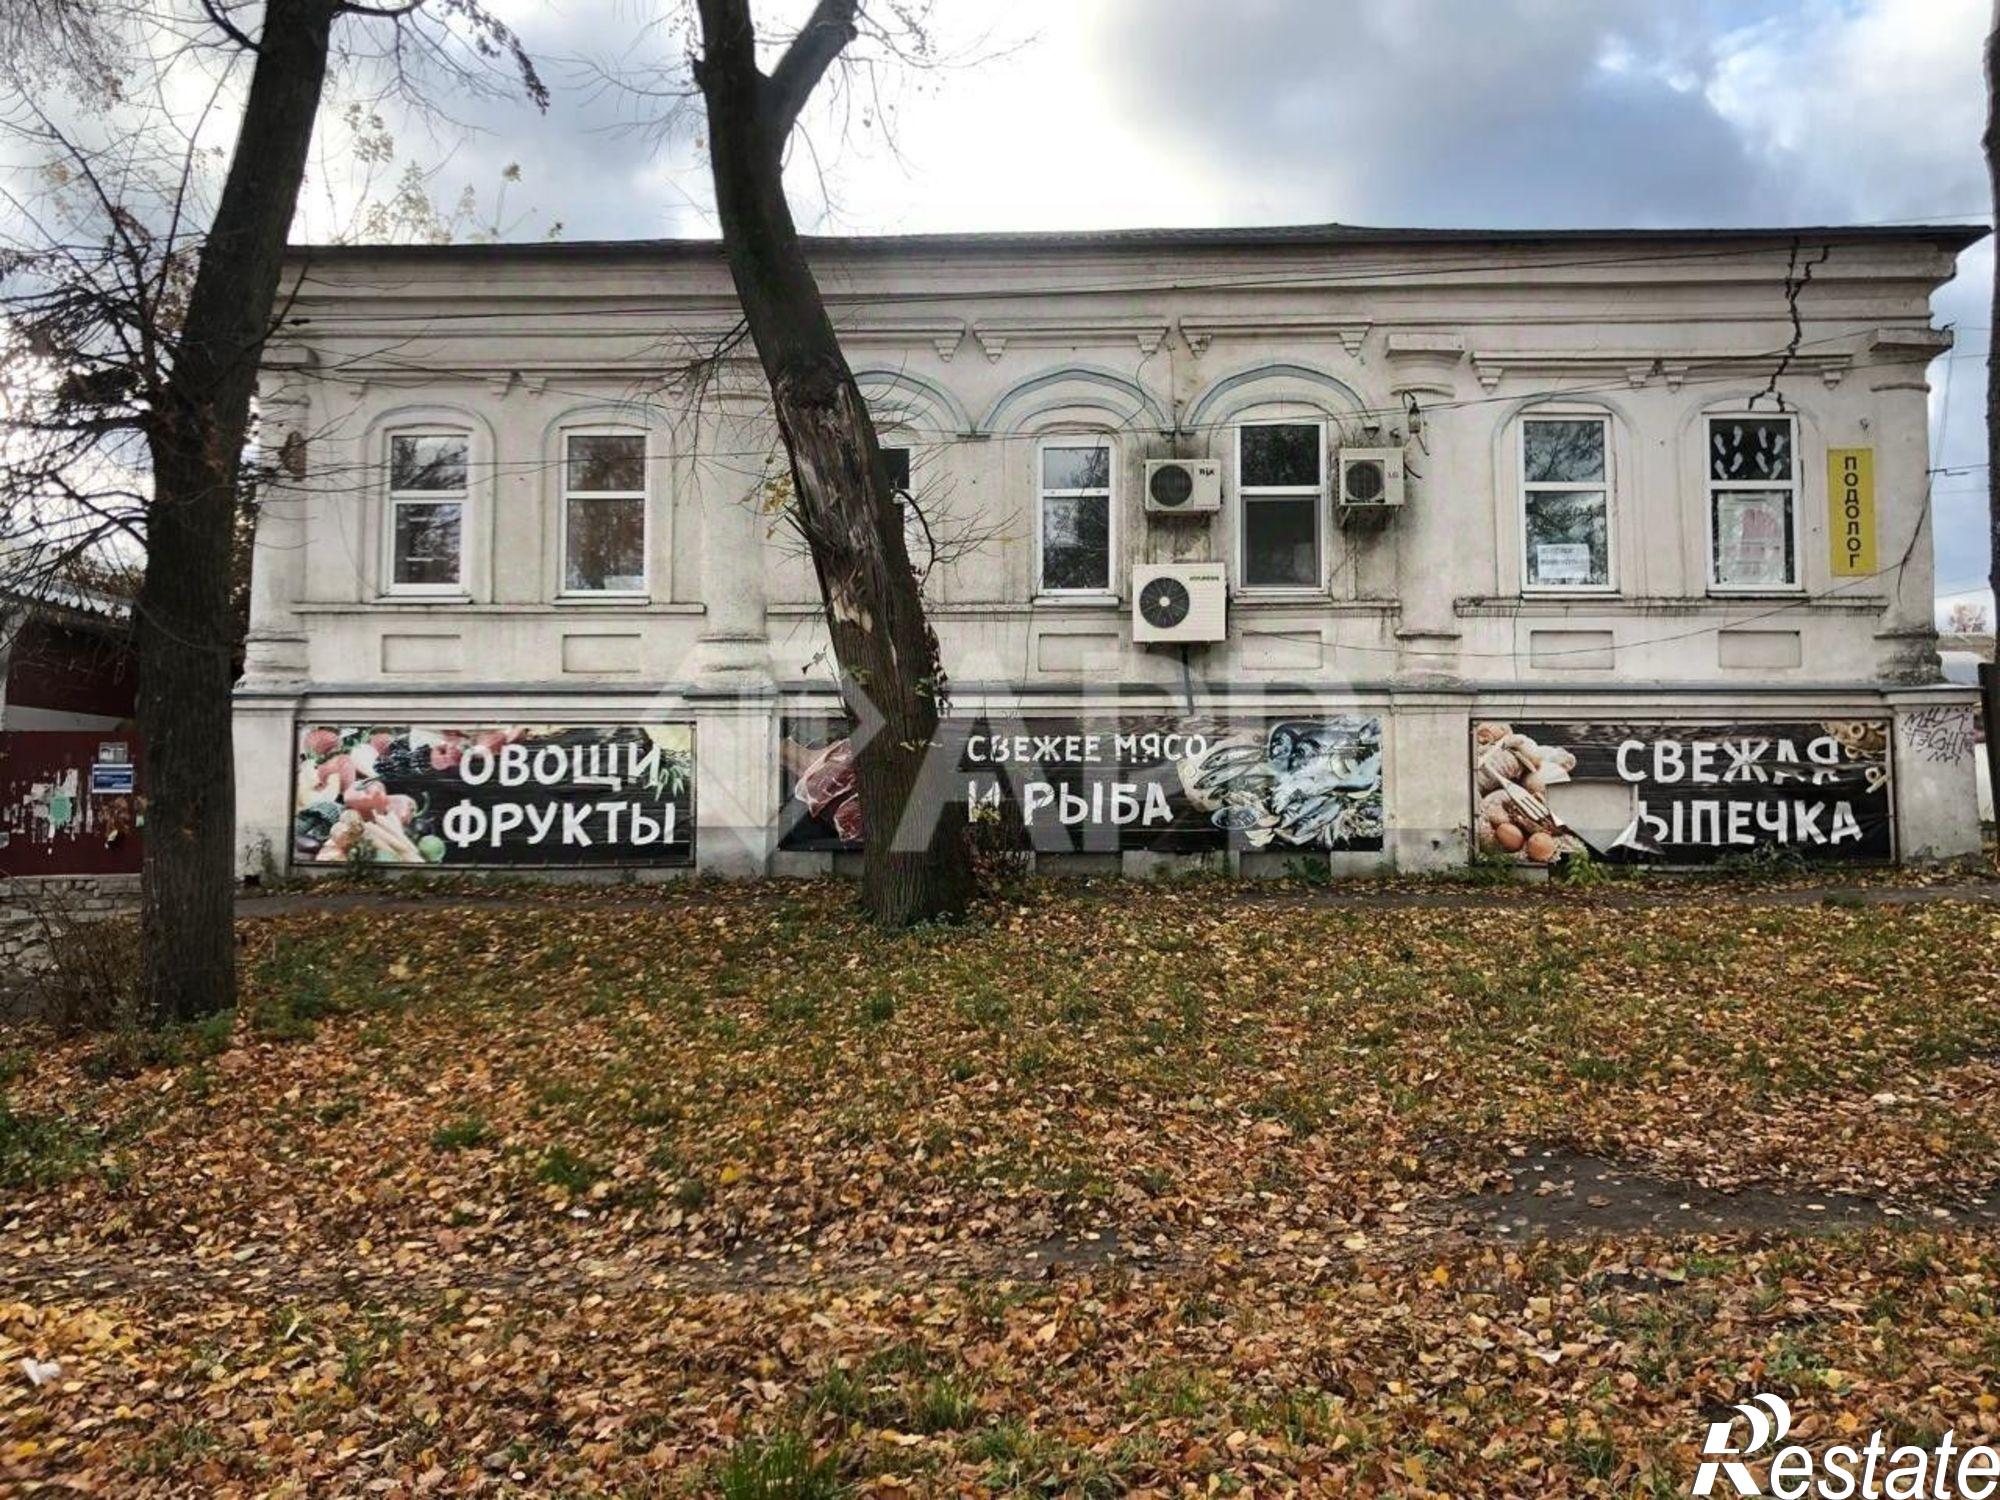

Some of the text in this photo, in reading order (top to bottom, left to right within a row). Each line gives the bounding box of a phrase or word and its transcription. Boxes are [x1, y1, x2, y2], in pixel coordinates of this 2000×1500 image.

[1844, 455, 1862, 568] ПОДОЛОГ
[459, 743, 662, 792] ОВОЩИ
[966, 733, 1208, 763] СВЕЖЕЕ МЯСО
[1616, 736, 1841, 785] СВЕЖАЯ
[442, 799, 676, 848] ФРУКТЫ
[1023, 781, 1175, 826] РЫБА
[1635, 799, 1864, 846] ЫПЕЧКА
